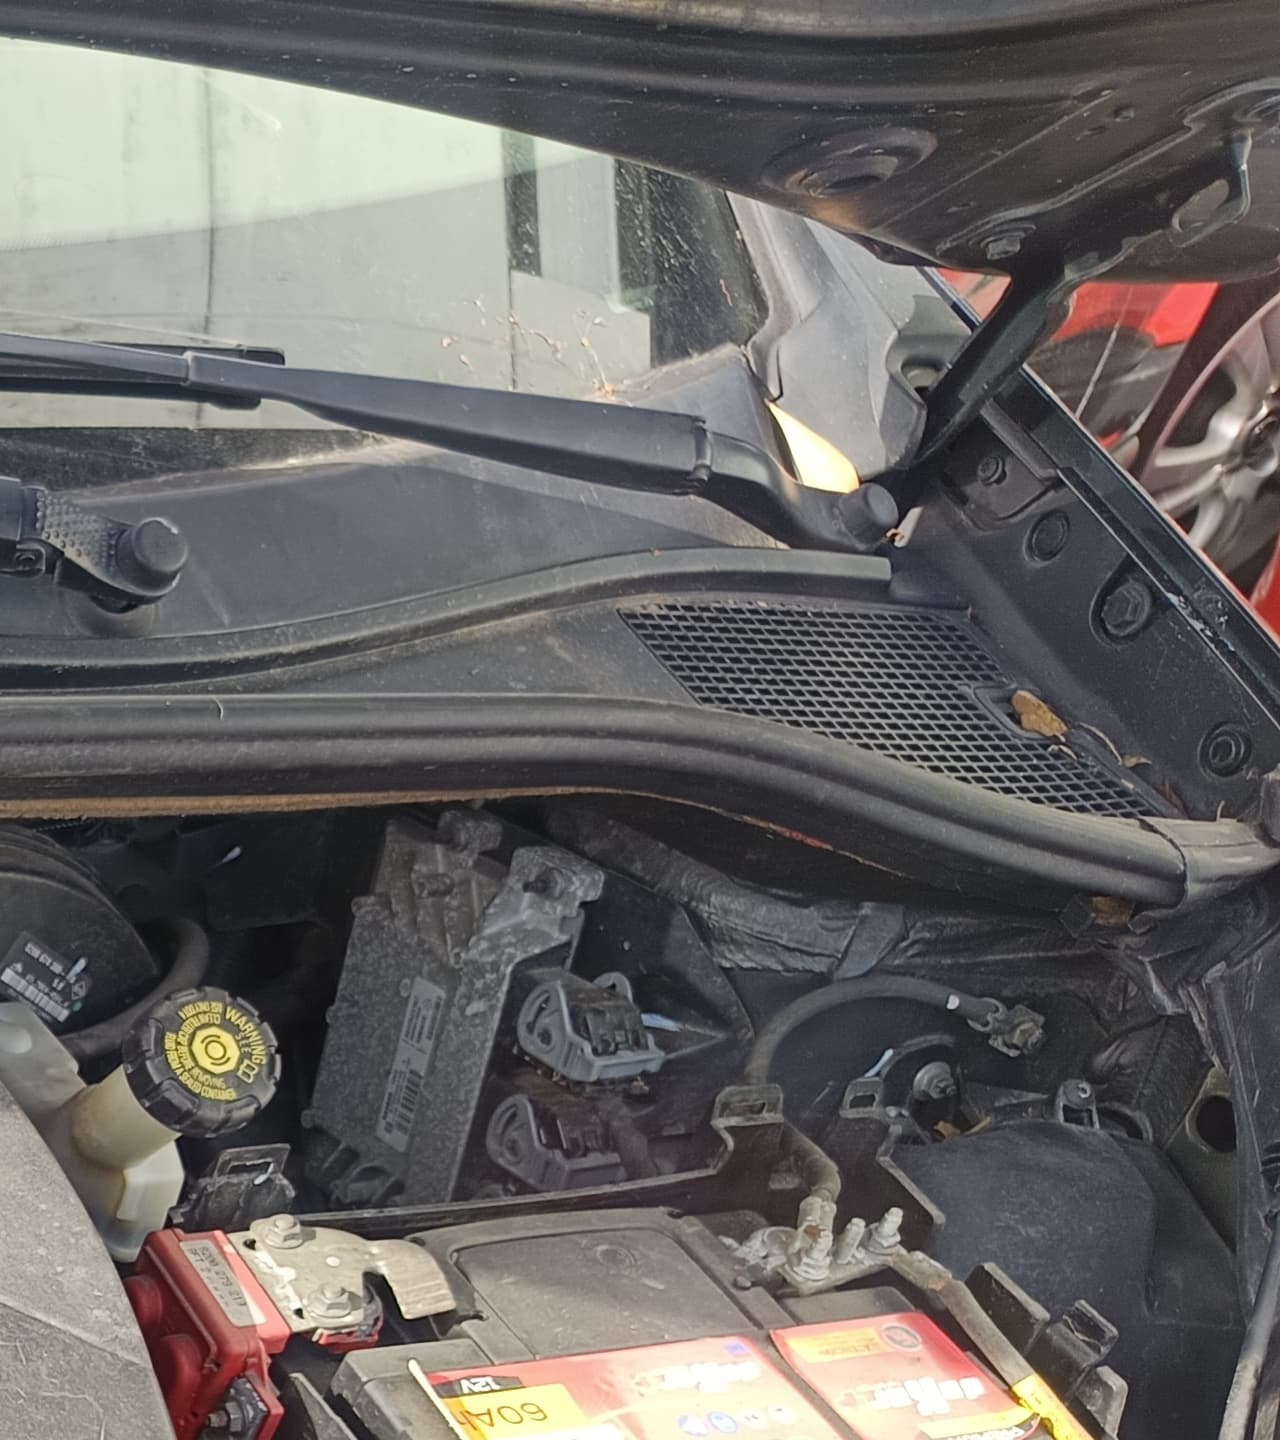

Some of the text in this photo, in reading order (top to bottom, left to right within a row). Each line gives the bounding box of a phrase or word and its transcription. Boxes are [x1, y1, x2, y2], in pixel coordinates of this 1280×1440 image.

[225, 1006, 267, 1065] WARNING
[235, 1031, 252, 1054] SEE
[460, 1376, 501, 1394] 12V
[456, 1402, 548, 1431] 60Ah
